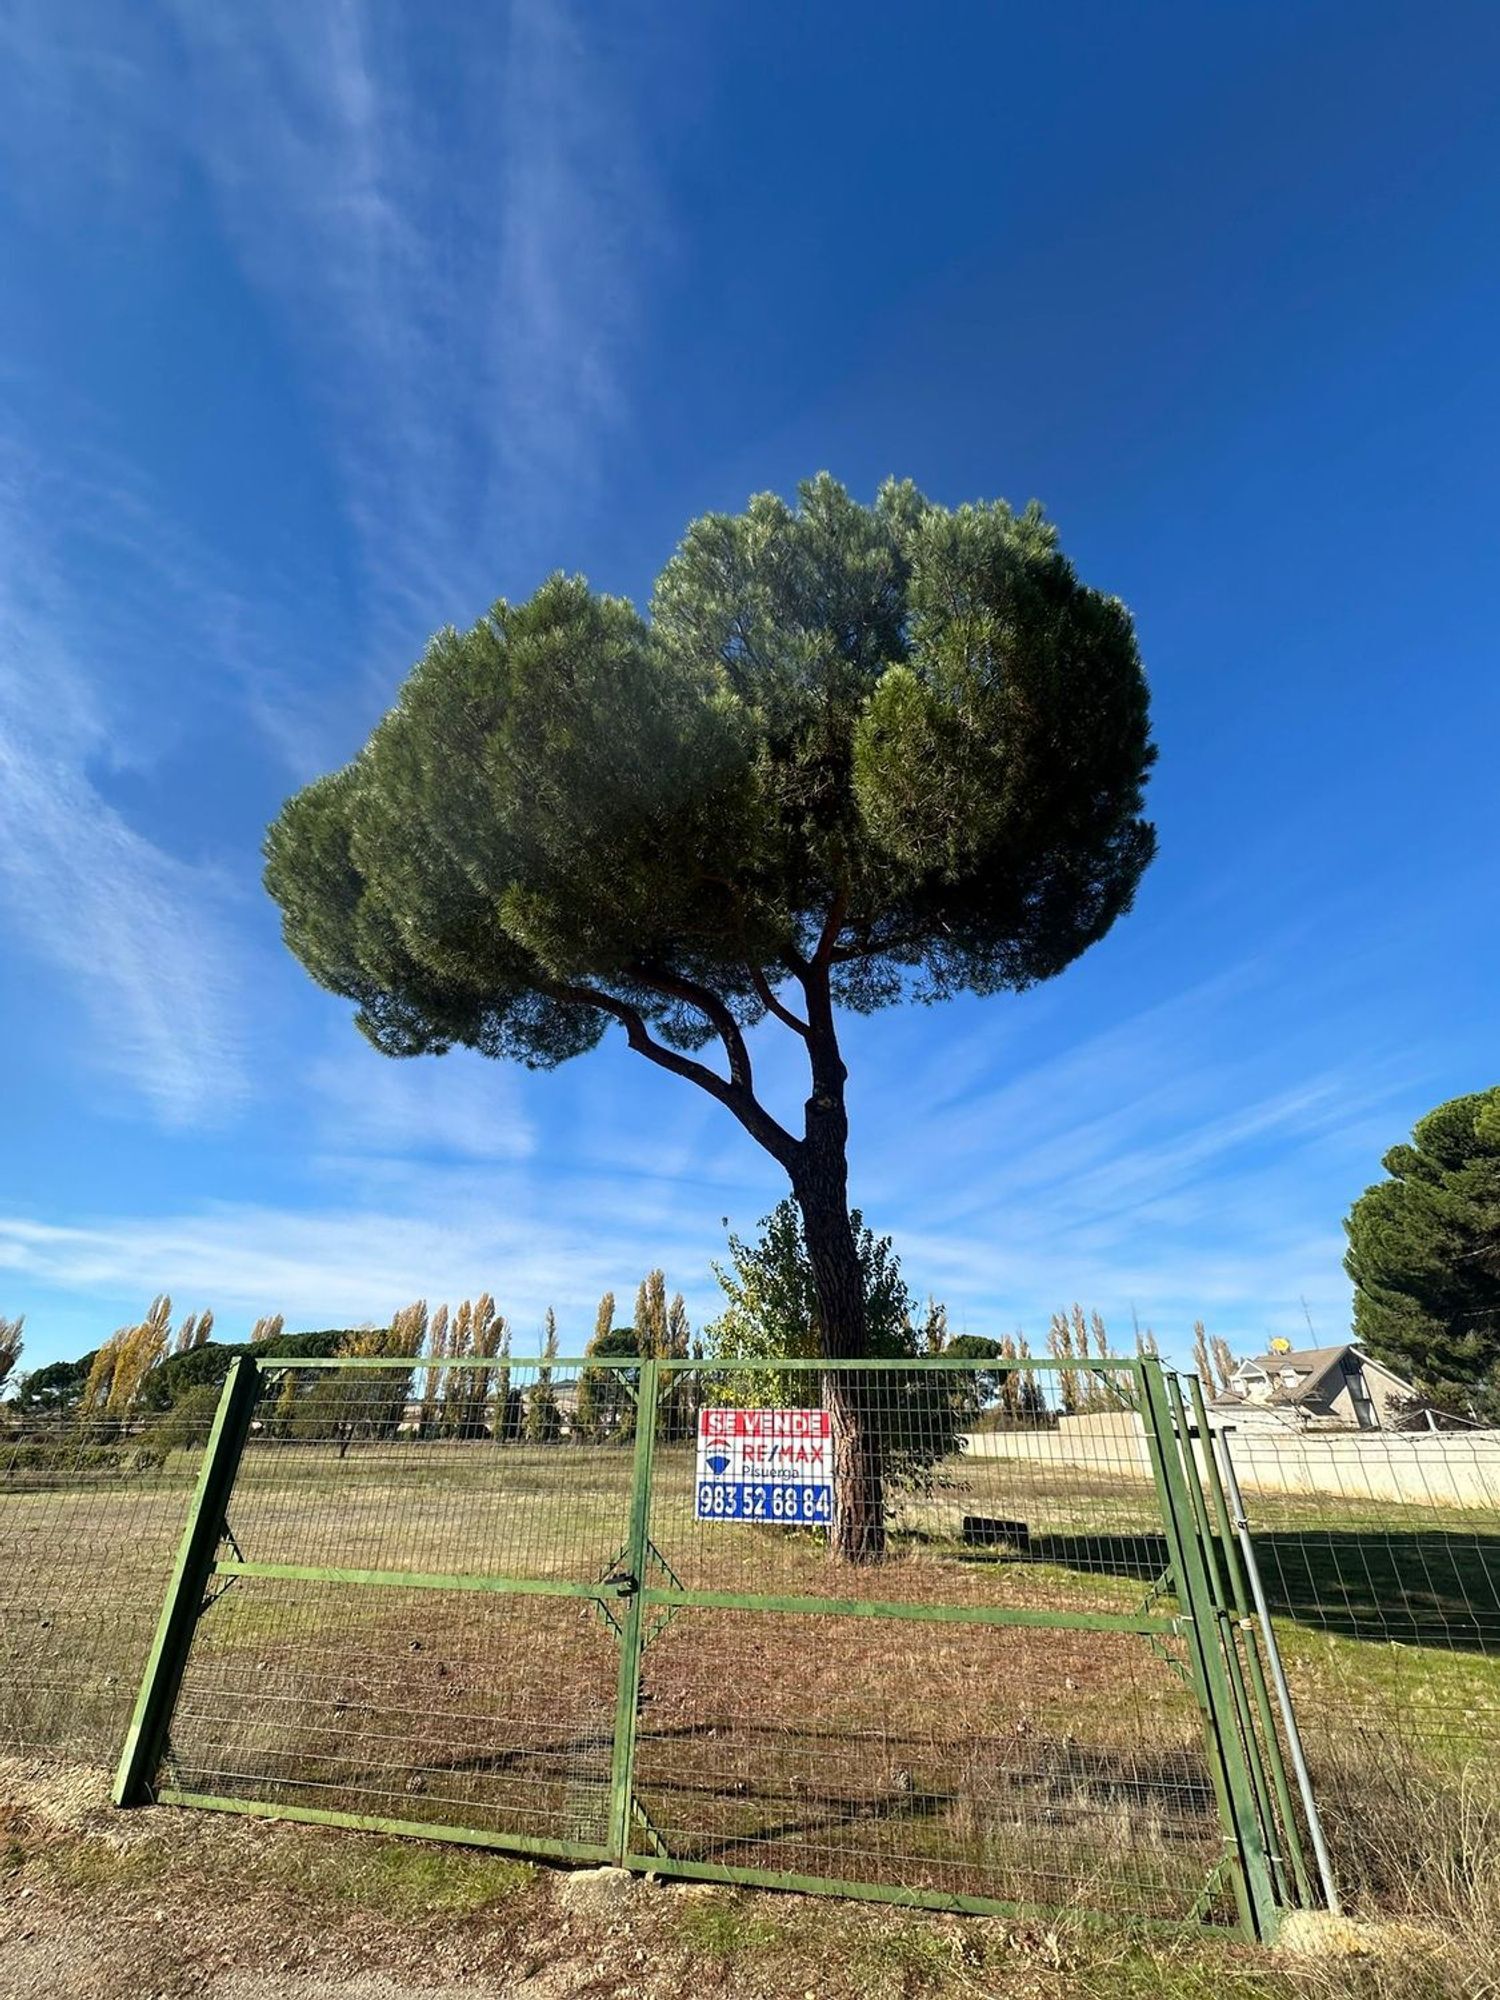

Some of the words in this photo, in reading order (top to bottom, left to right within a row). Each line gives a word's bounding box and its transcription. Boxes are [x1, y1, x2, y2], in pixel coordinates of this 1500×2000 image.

[708, 1413, 736, 1436] SE
[743, 1413, 822, 1437] VENDE
[742, 1444, 823, 1463] RE/MAX
[742, 1465, 799, 1481] Pisuerga
[700, 1485, 737, 1514] 983
[743, 1487, 767, 1515] 52
[773, 1487, 797, 1516] 68
[803, 1488, 829, 1517] 84
